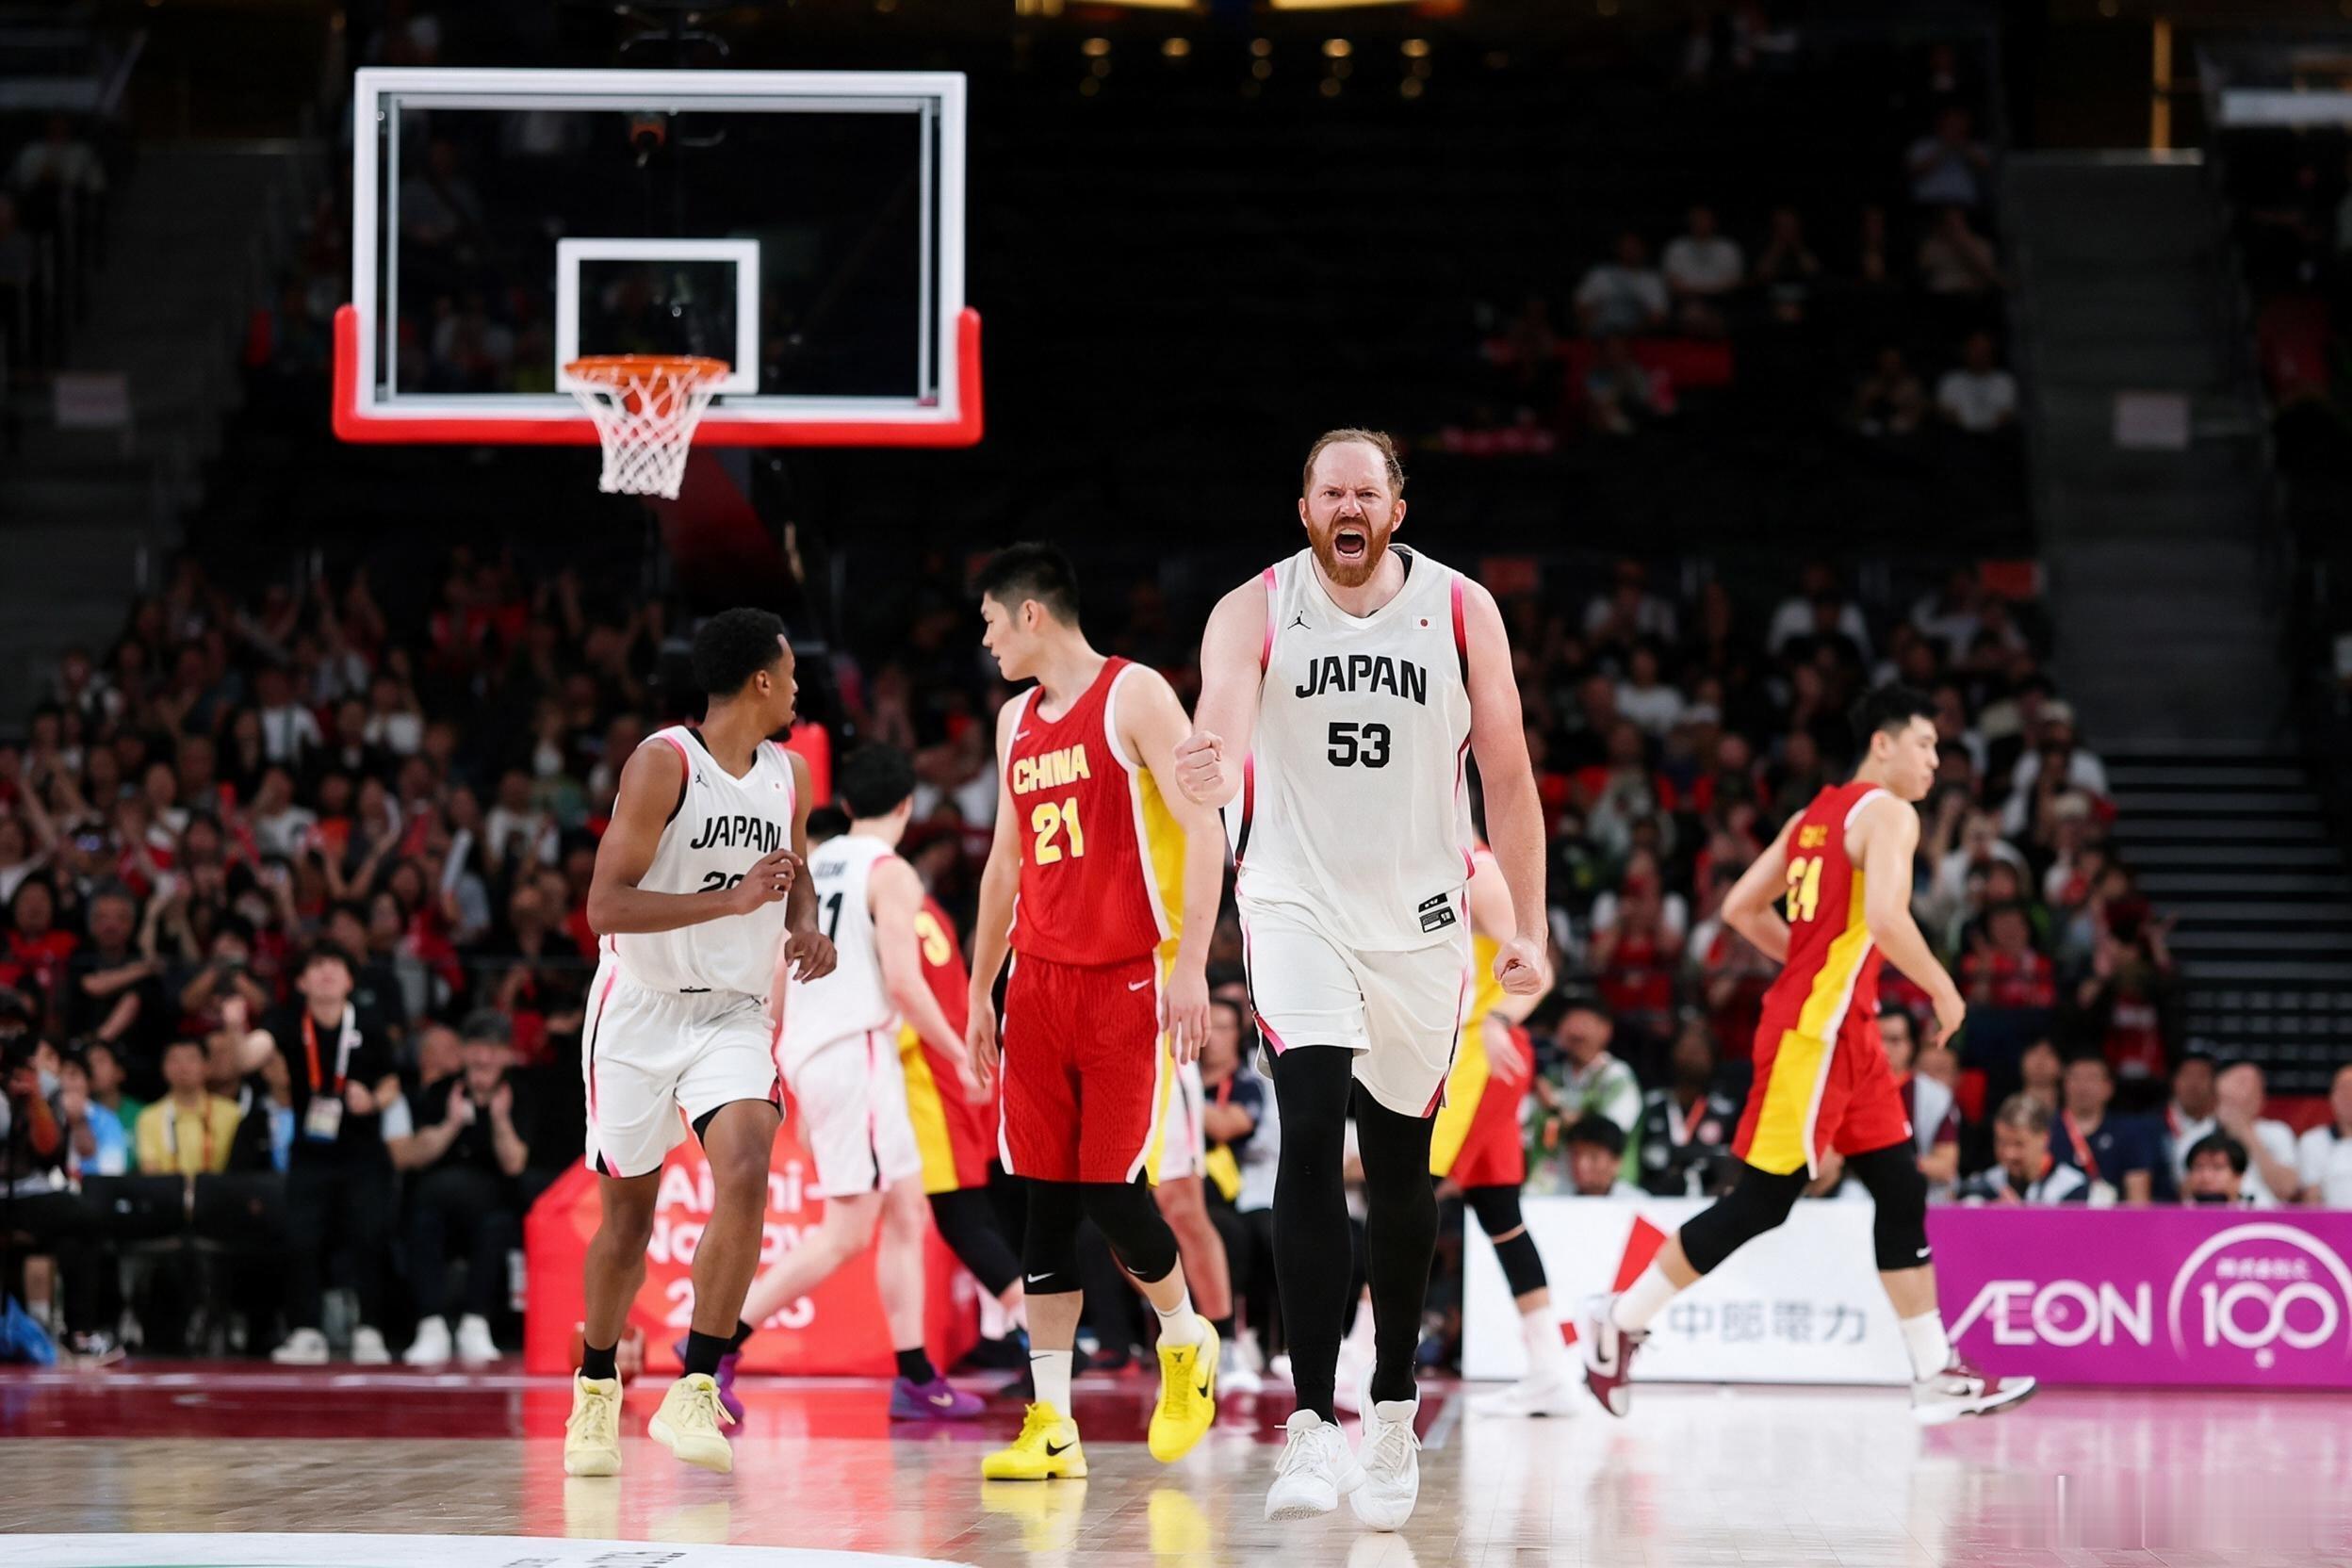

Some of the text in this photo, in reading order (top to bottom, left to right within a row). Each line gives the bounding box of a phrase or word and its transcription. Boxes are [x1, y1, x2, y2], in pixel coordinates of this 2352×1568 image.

[1295, 654, 1427, 706] JAPAN
[1012, 743, 1092, 795] CHINA
[1327, 722, 1391, 768] 53
[690, 815, 782, 854] JAPAN
[1030, 795, 1086, 866] 21
[816, 891, 844, 944] 1
[2199, 1280, 2341, 1350] 100
